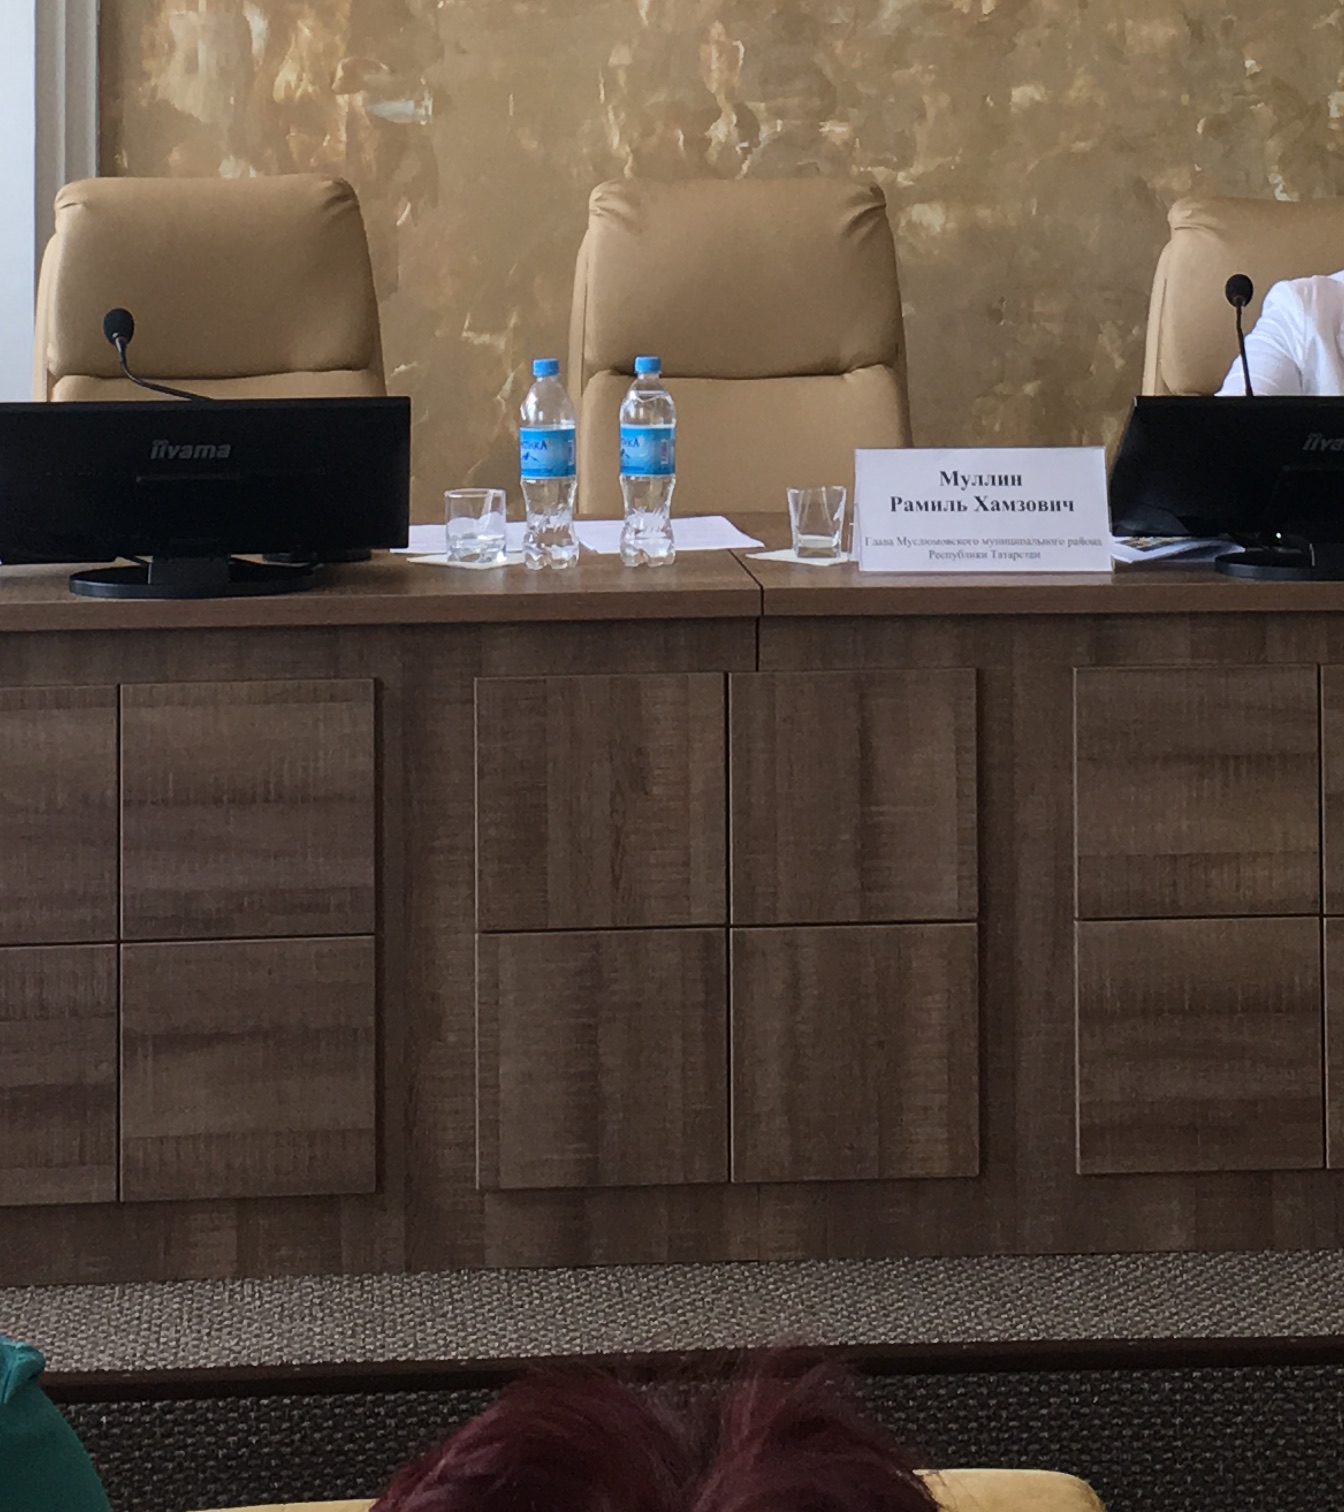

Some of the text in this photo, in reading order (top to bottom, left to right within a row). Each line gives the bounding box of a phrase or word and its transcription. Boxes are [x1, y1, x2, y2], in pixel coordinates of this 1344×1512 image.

[150, 439, 232, 459] iiyama
[939, 471, 1023, 490] Муллин
[889, 495, 1075, 513] Рамиль Хамзович
